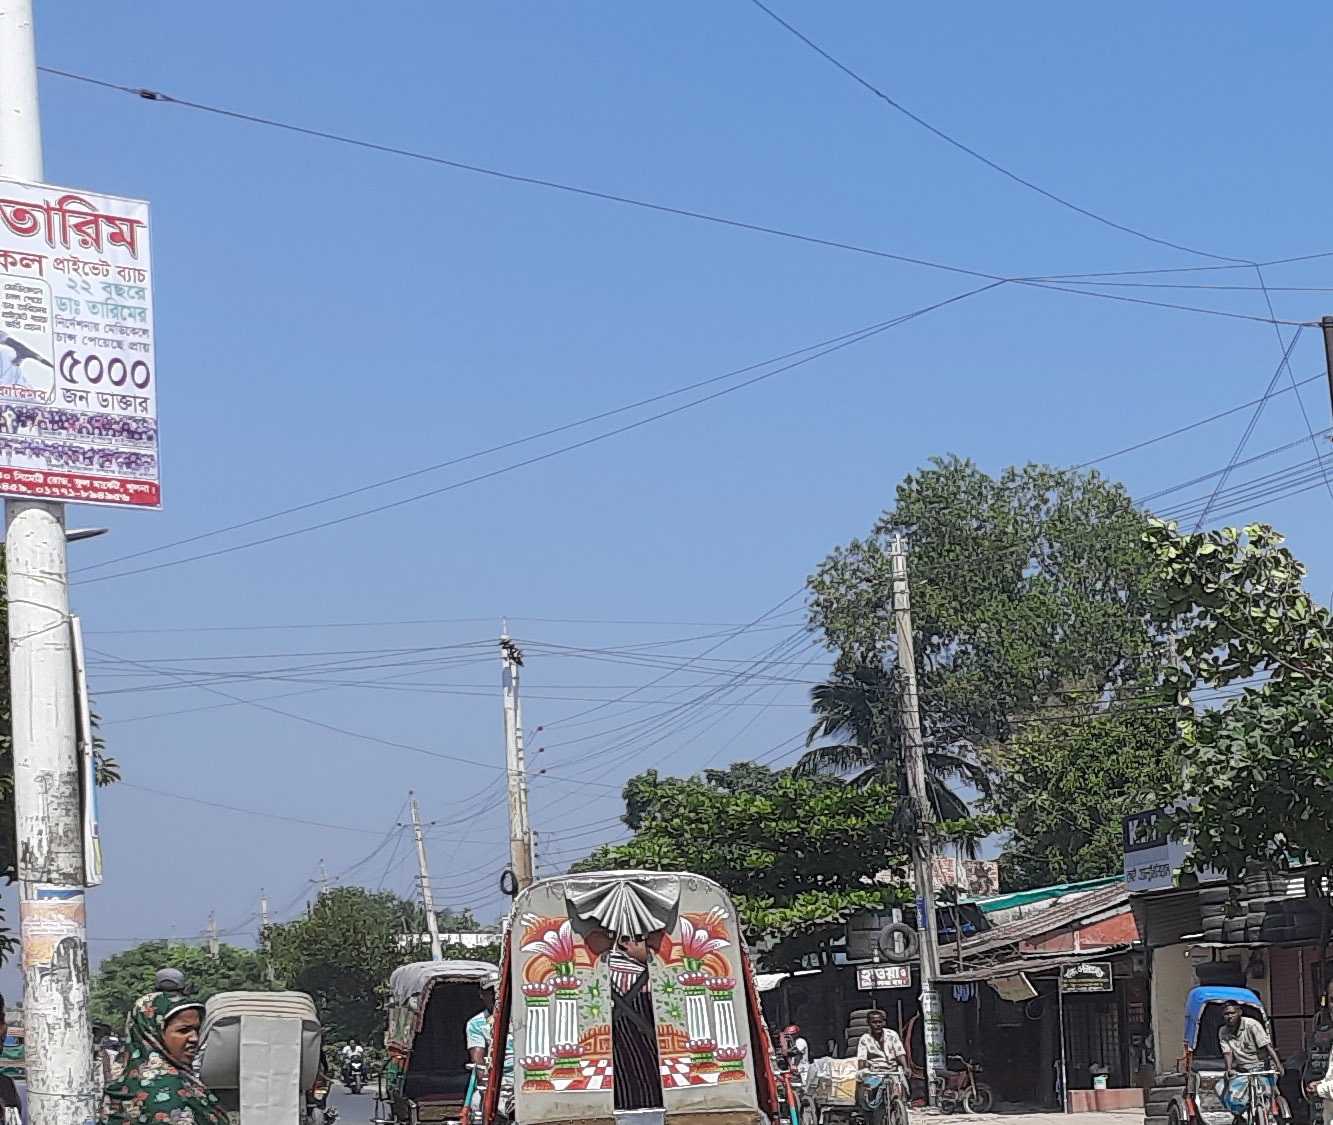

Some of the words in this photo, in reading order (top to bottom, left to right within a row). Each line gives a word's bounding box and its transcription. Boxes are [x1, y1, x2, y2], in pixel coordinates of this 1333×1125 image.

[53, 254, 111, 278] প্রাইভেট
[115, 265, 147, 283] ব্যাচ
[67, 278, 94, 296] ২২
[54, 296, 81, 315] ডাঃ
[85, 297, 148, 323] তারিমের
[60, 350, 150, 389] ৫০০০
[60, 388, 91, 408] জন
[96, 391, 150, 414] ডাক্তার
